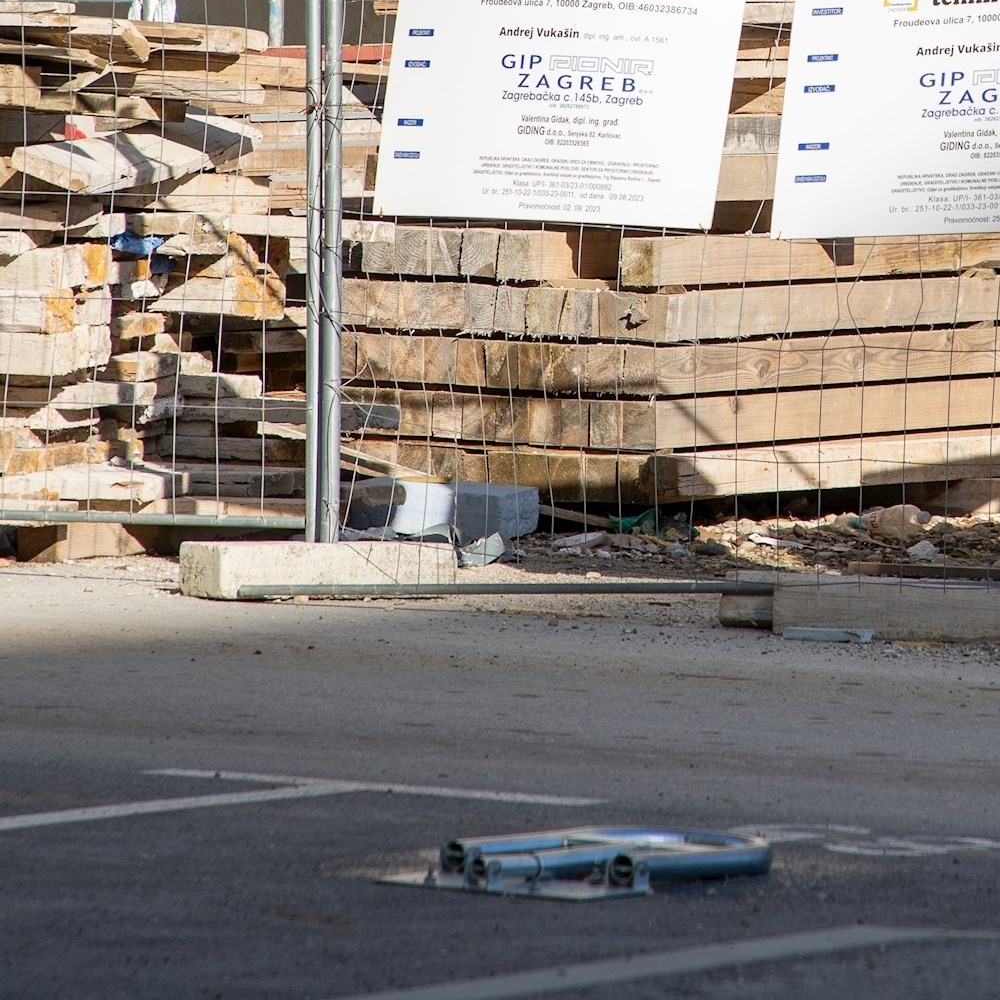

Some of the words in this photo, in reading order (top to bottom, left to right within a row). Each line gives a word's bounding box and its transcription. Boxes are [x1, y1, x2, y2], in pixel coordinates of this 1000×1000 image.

[582, 0, 615, 11] Zagreb,
[893, 18, 940, 28] Froudeova
[943, 16, 964, 25] ulica
[499, 27, 534, 40] Andrej
[916, 45, 954, 57] Andrej
[501, 54, 542, 70] GIP
[517, 73, 635, 92] ZAGREB
[919, 71, 965, 88] GIP
[502, 90, 561, 103] Zagrebačka
[605, 94, 643, 107] Zagreb
[521, 114, 550, 123] Valentina
[921, 106, 986, 120] Zagrebačka
[944, 130, 975, 139] Valentina
[928, 195, 951, 203] Klasa:
